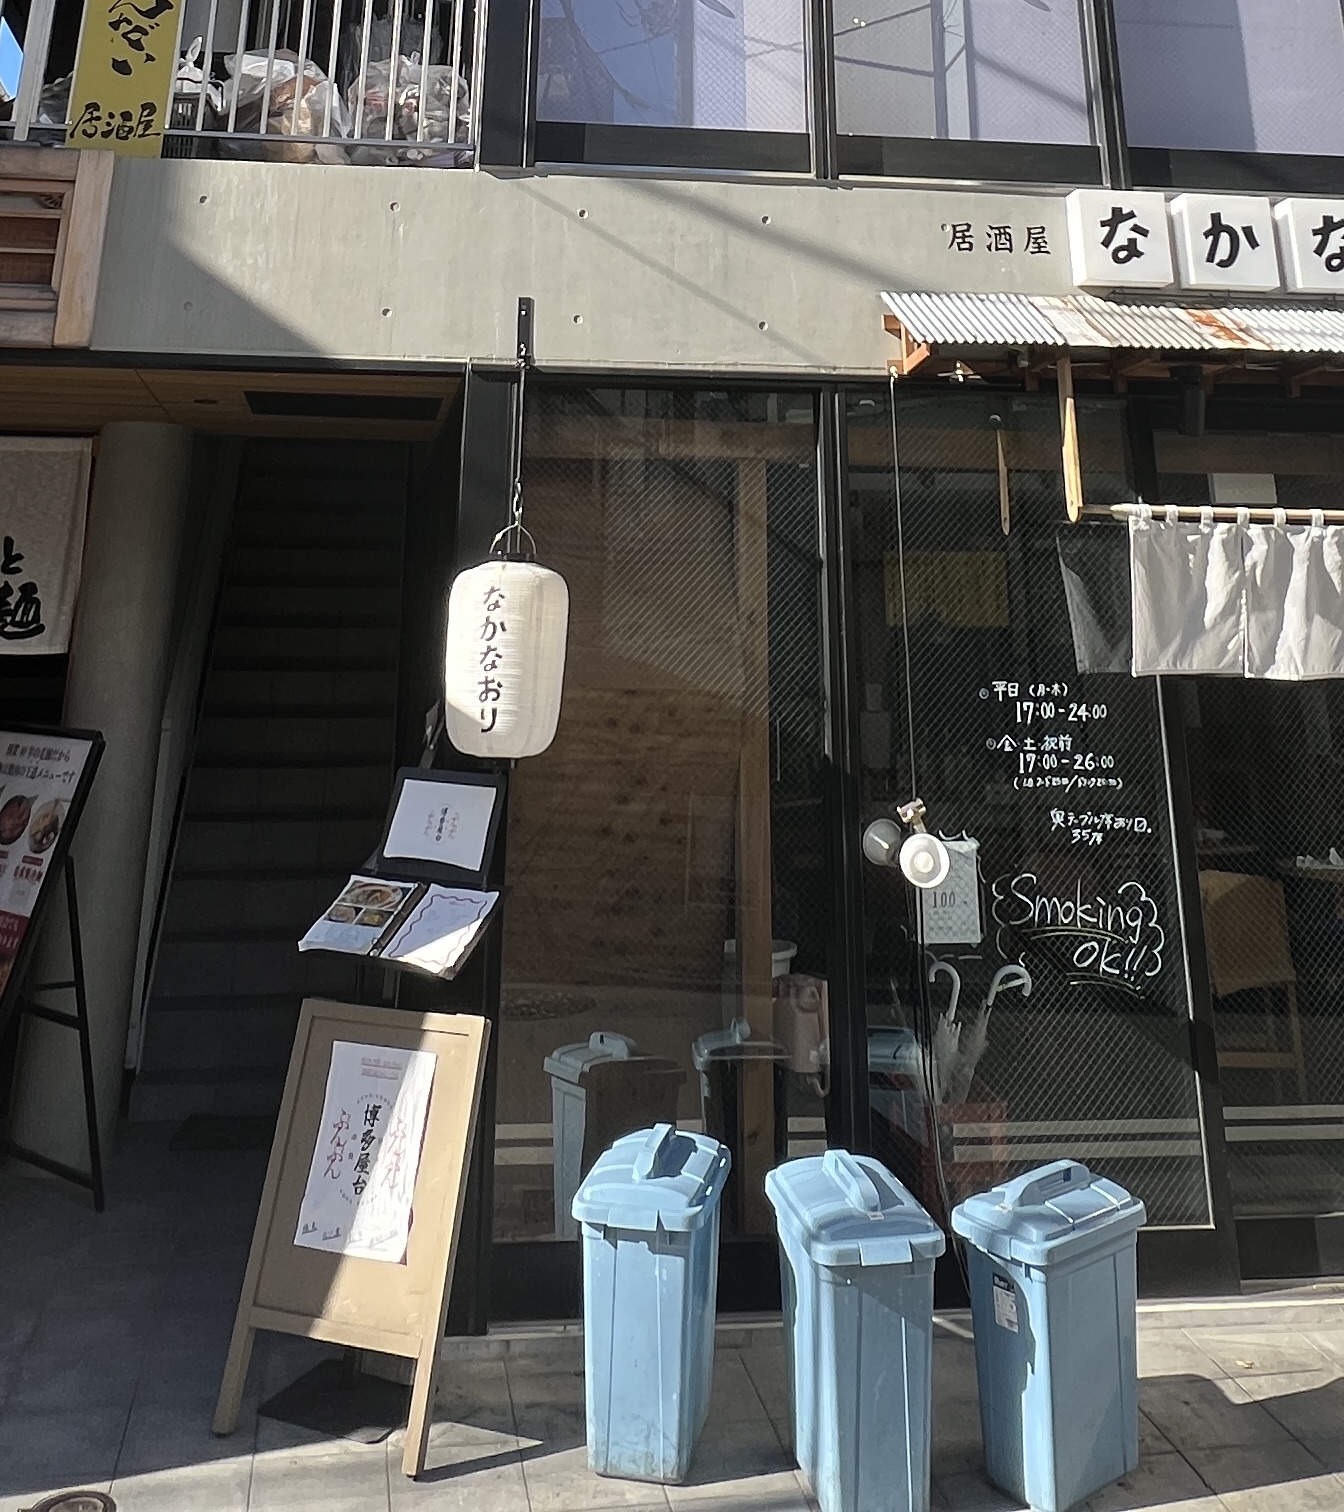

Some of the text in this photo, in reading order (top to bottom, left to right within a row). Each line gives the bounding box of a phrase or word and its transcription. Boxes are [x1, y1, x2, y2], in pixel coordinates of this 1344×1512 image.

[69, 101, 162, 140] 居酒屋
[947, 221, 1052, 256] 居酒屋
[478, 586, 507, 733] なかなおり
[991, 680, 1020, 702] 平日
[1010, 873, 1144, 944] Smoking
[352, 1104, 382, 1196] 博多屋台
